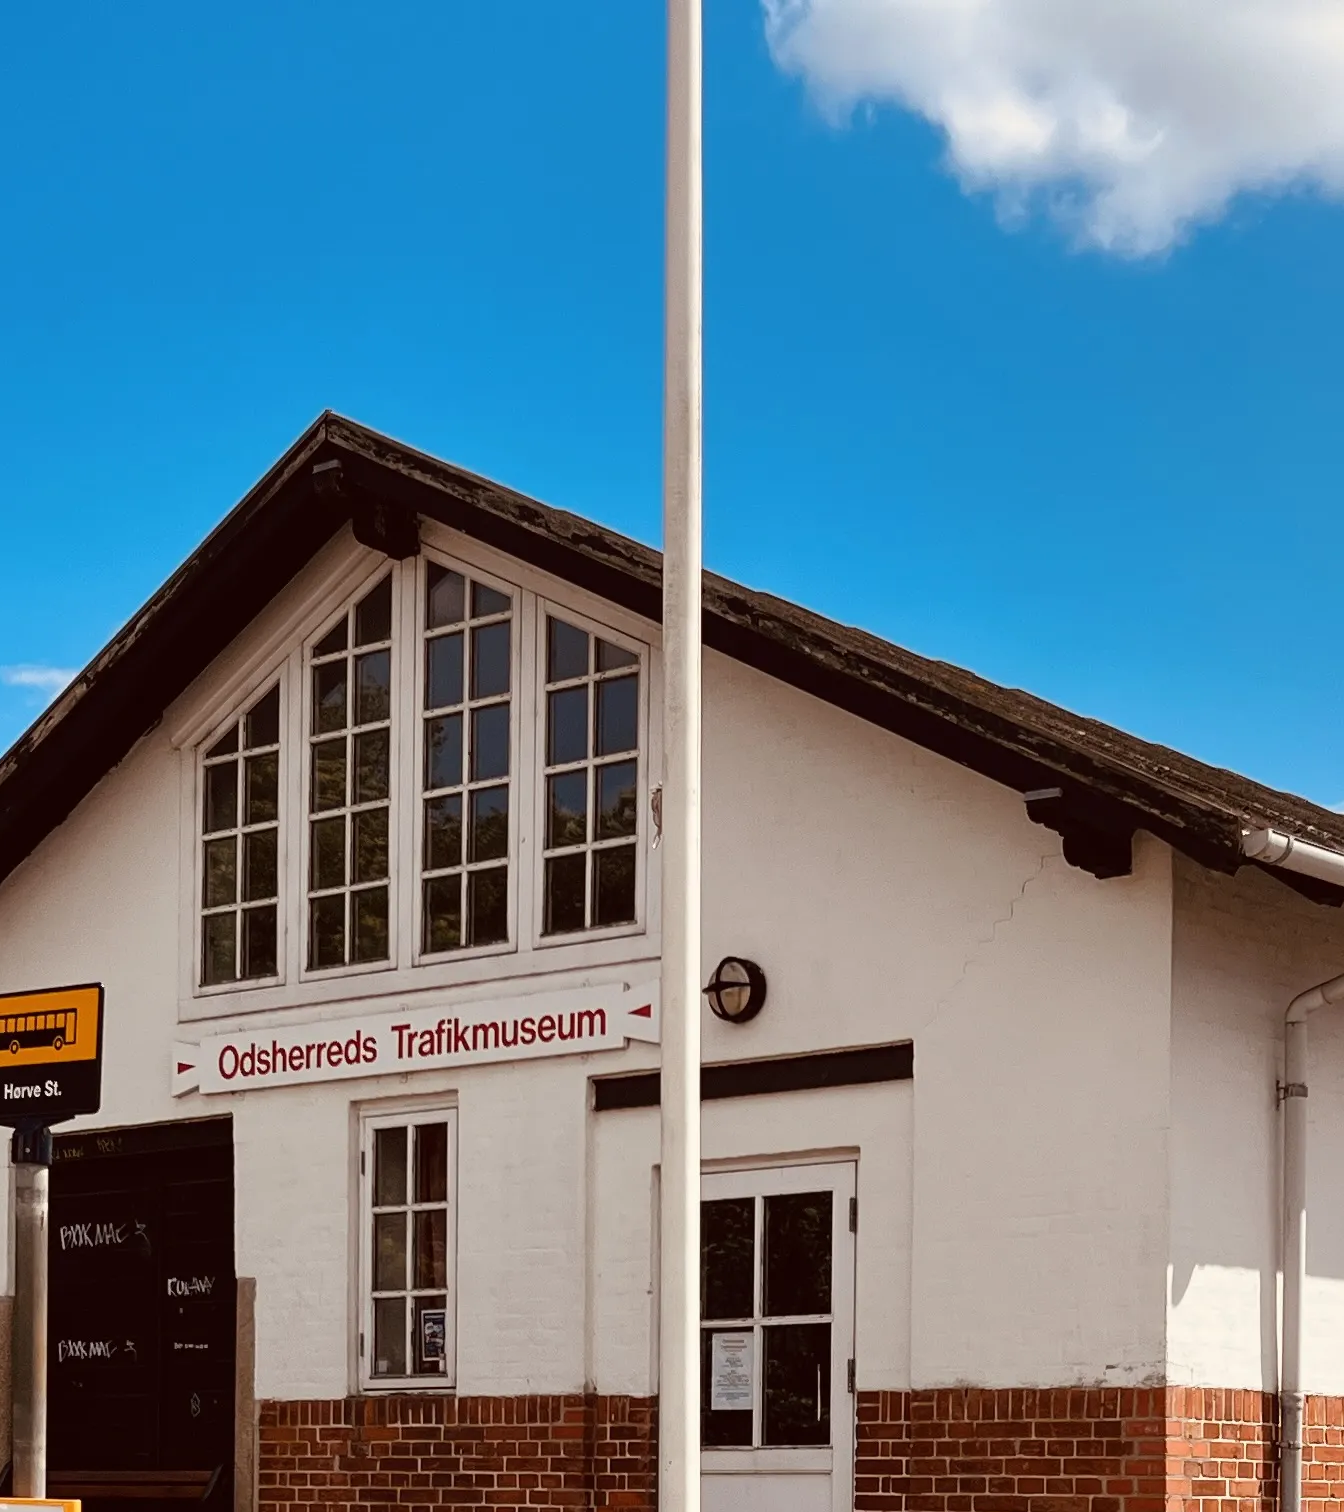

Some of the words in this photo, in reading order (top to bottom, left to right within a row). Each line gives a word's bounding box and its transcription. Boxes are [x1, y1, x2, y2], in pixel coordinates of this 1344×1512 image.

[218, 1030, 377, 1079] Odsherreds
[391, 1008, 606, 1060] Trafikmuseum
[4, 1083, 41, 1099] Hørve
[44, 1080, 62, 1097] St.
